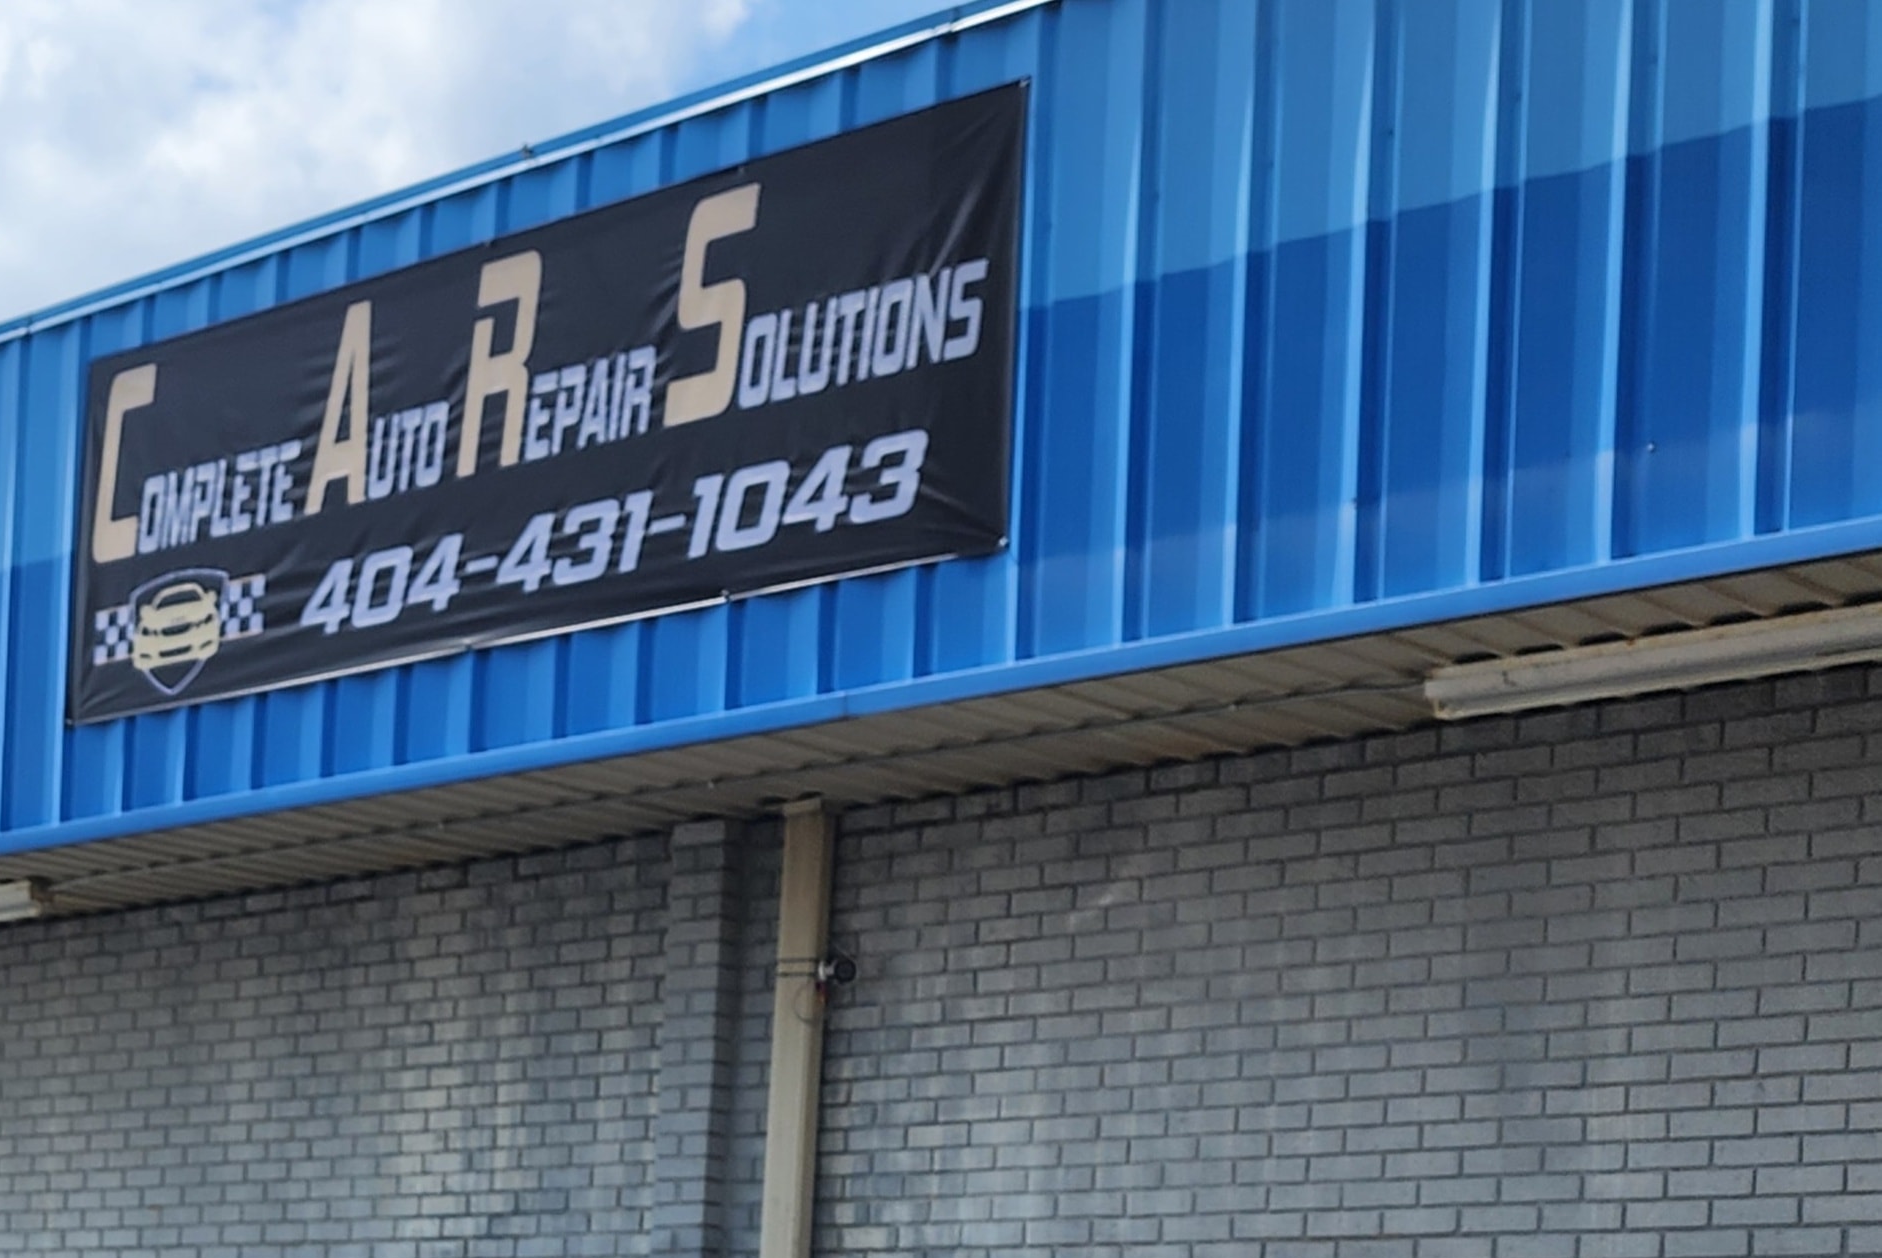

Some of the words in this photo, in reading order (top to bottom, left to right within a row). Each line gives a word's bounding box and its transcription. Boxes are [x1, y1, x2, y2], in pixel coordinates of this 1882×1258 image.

[93, 362, 302, 564] COMPLETE
[303, 299, 450, 516] AUTO
[456, 249, 658, 478] REPAIR
[663, 182, 990, 428] SOLUTIONS
[301, 429, 930, 636] 404-431-1043
